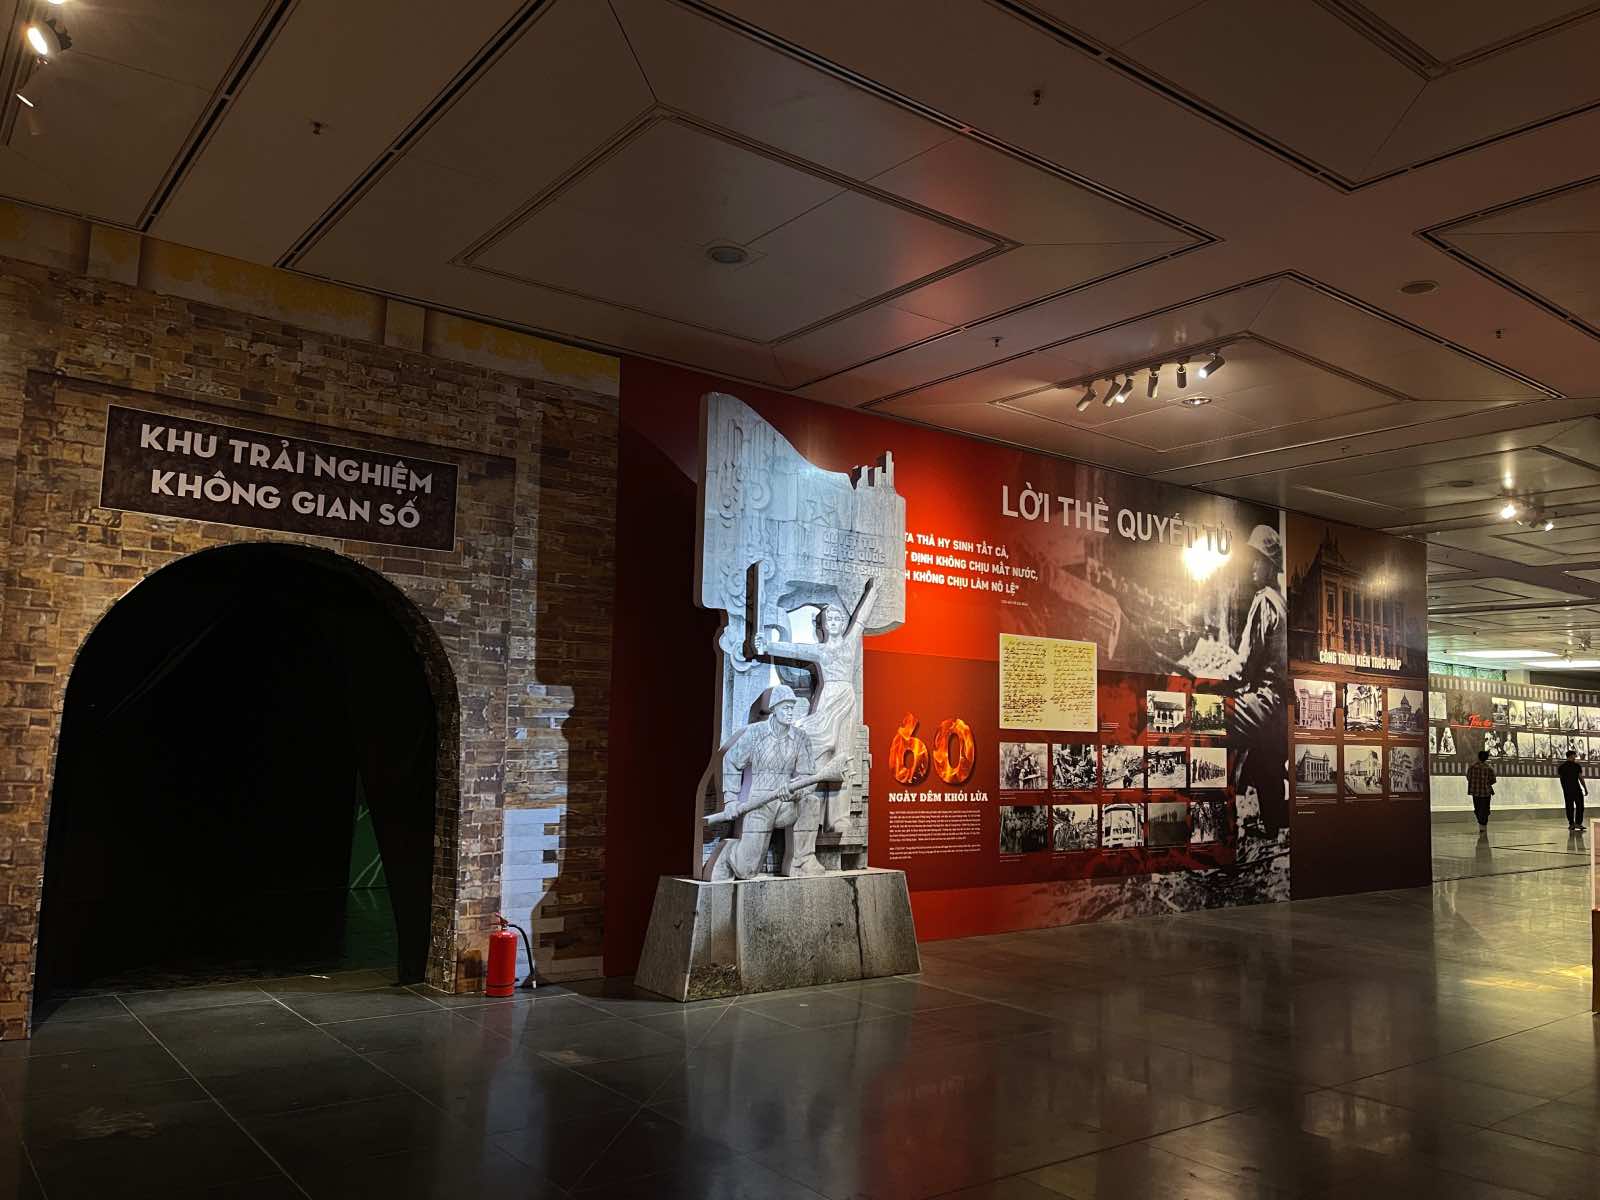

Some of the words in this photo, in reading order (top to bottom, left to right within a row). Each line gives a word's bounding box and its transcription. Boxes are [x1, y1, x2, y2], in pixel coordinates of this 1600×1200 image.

[140, 424, 217, 458] KHU
[229, 440, 305, 474] TRẢI
[314, 454, 433, 495] NGHIỆM
[151, 470, 281, 509] KHÔNG
[292, 491, 371, 523] GIAN
[378, 495, 420, 529] SỐ
[1002, 482, 1050, 523] LỜI
[1057, 496, 1110, 534] THỀ
[1117, 509, 1199, 548] QUYẾT
[916, 532, 936, 546] THẢ
[938, 537, 950, 549] HY
[953, 540, 974, 553] SINH
[976, 540, 993, 556] TẤT
[995, 544, 1009, 559] CẢ,
[911, 551, 934, 566] ĐỊNH
[936, 555, 967, 570] KHÔNG
[969, 561, 990, 575] CHỊU
[992, 561, 1010, 576] MẤT
[1012, 566, 1038, 581] NƯỚC,
[913, 570, 945, 585] KHÔNG
[947, 575, 969, 590] CHỊU
[970, 577, 989, 591] LÀM
[991, 582, 1004, 593] NÔ
[1320, 649, 1337, 665] CÔNG
[1356, 652, 1371, 668] KIẾN
[1386, 656, 1402, 671] PHÁP
[889, 711, 976, 785] 60
[888, 789, 917, 802] NGÀY
[920, 790, 942, 802] ĐÊM
[944, 789, 968, 802] KHÓI
[970, 789, 989, 802] LỬA
